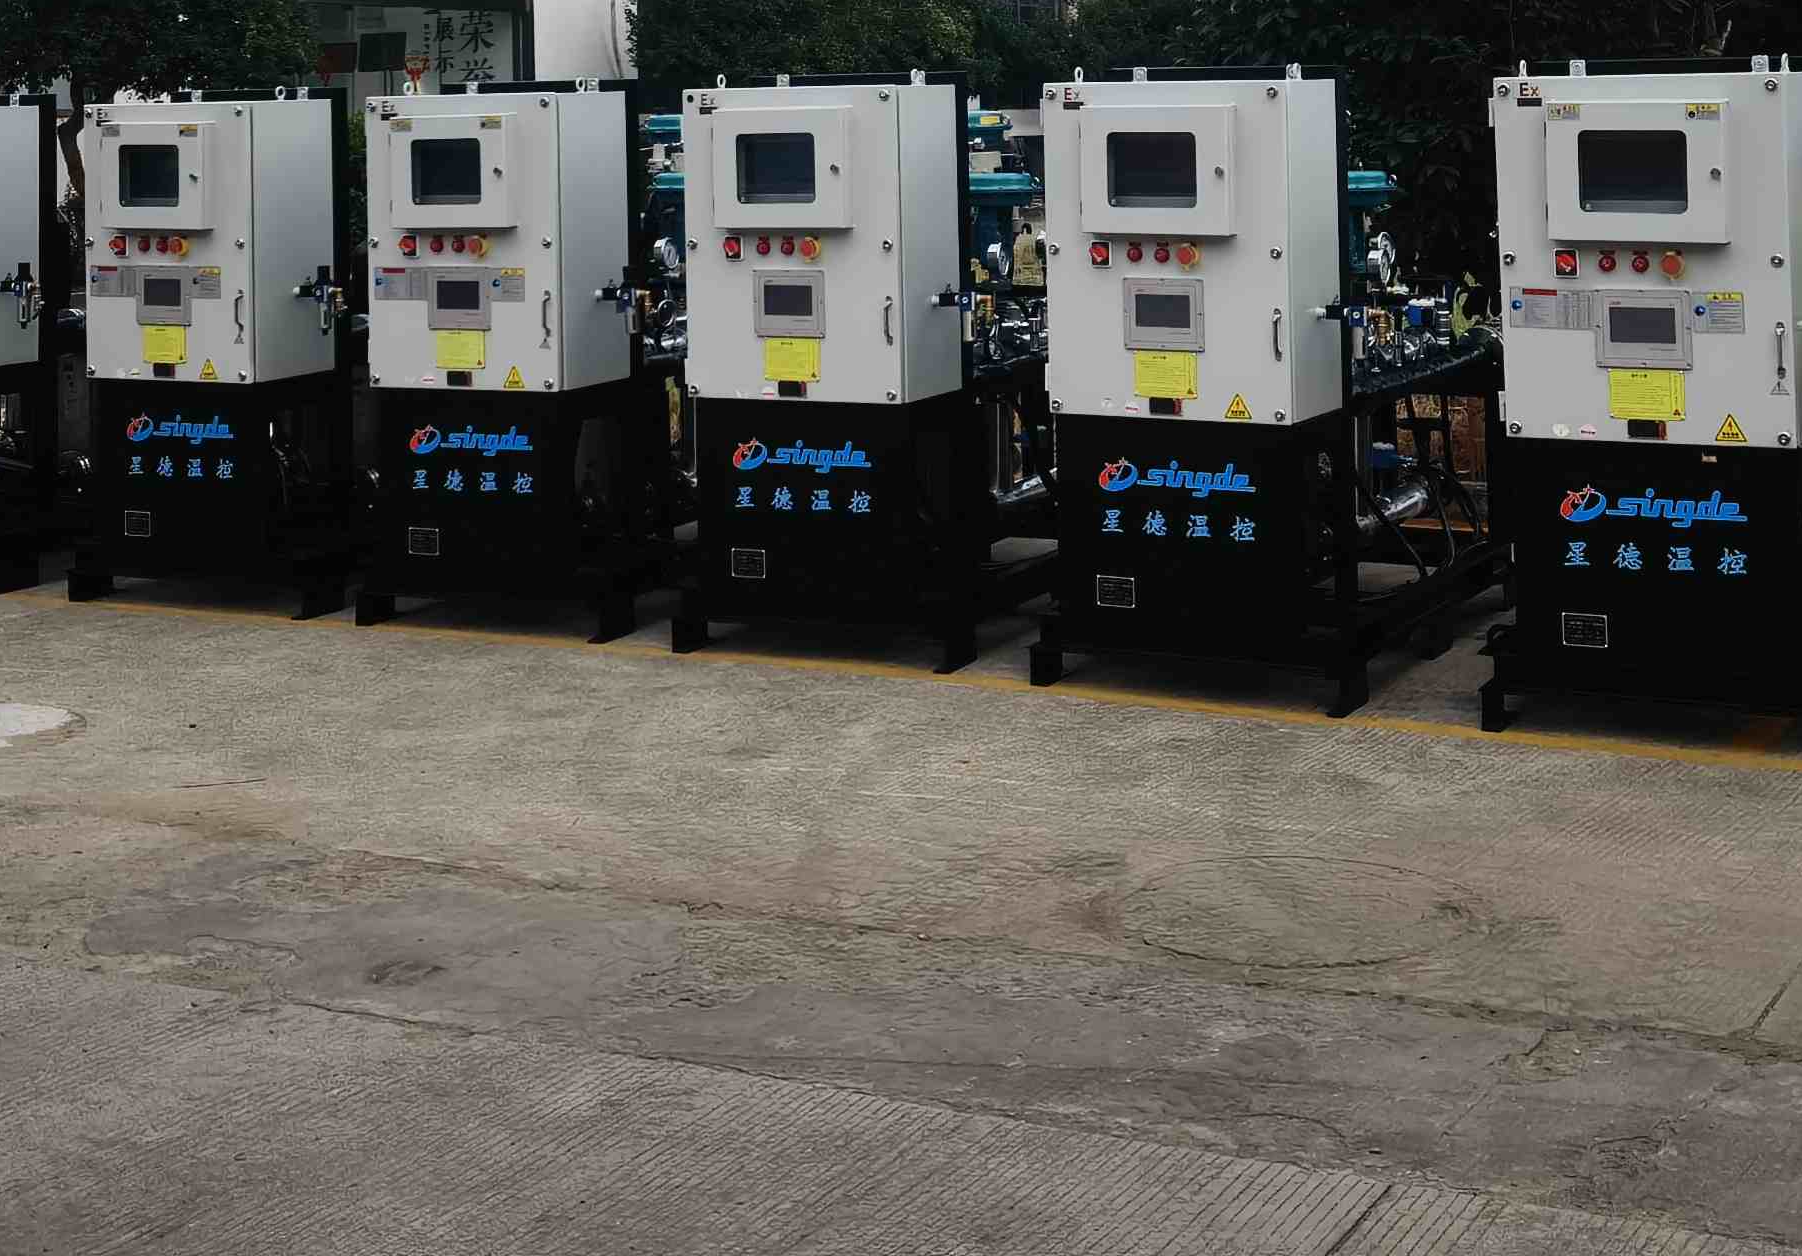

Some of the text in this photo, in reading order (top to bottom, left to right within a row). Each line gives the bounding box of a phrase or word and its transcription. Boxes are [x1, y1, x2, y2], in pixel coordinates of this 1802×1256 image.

[1519, 82, 1540, 97] Ex
[153, 414, 235, 445] singde
[440, 424, 534, 457] singde
[766, 439, 872, 474] singde
[412, 469, 534, 494] 星德温控
[1137, 459, 1256, 498] singde
[734, 485, 872, 514] 星德温控
[1606, 487, 1748, 529] singde
[1101, 508, 1256, 543] 星德温控
[1563, 540, 1749, 576] 星德温控
